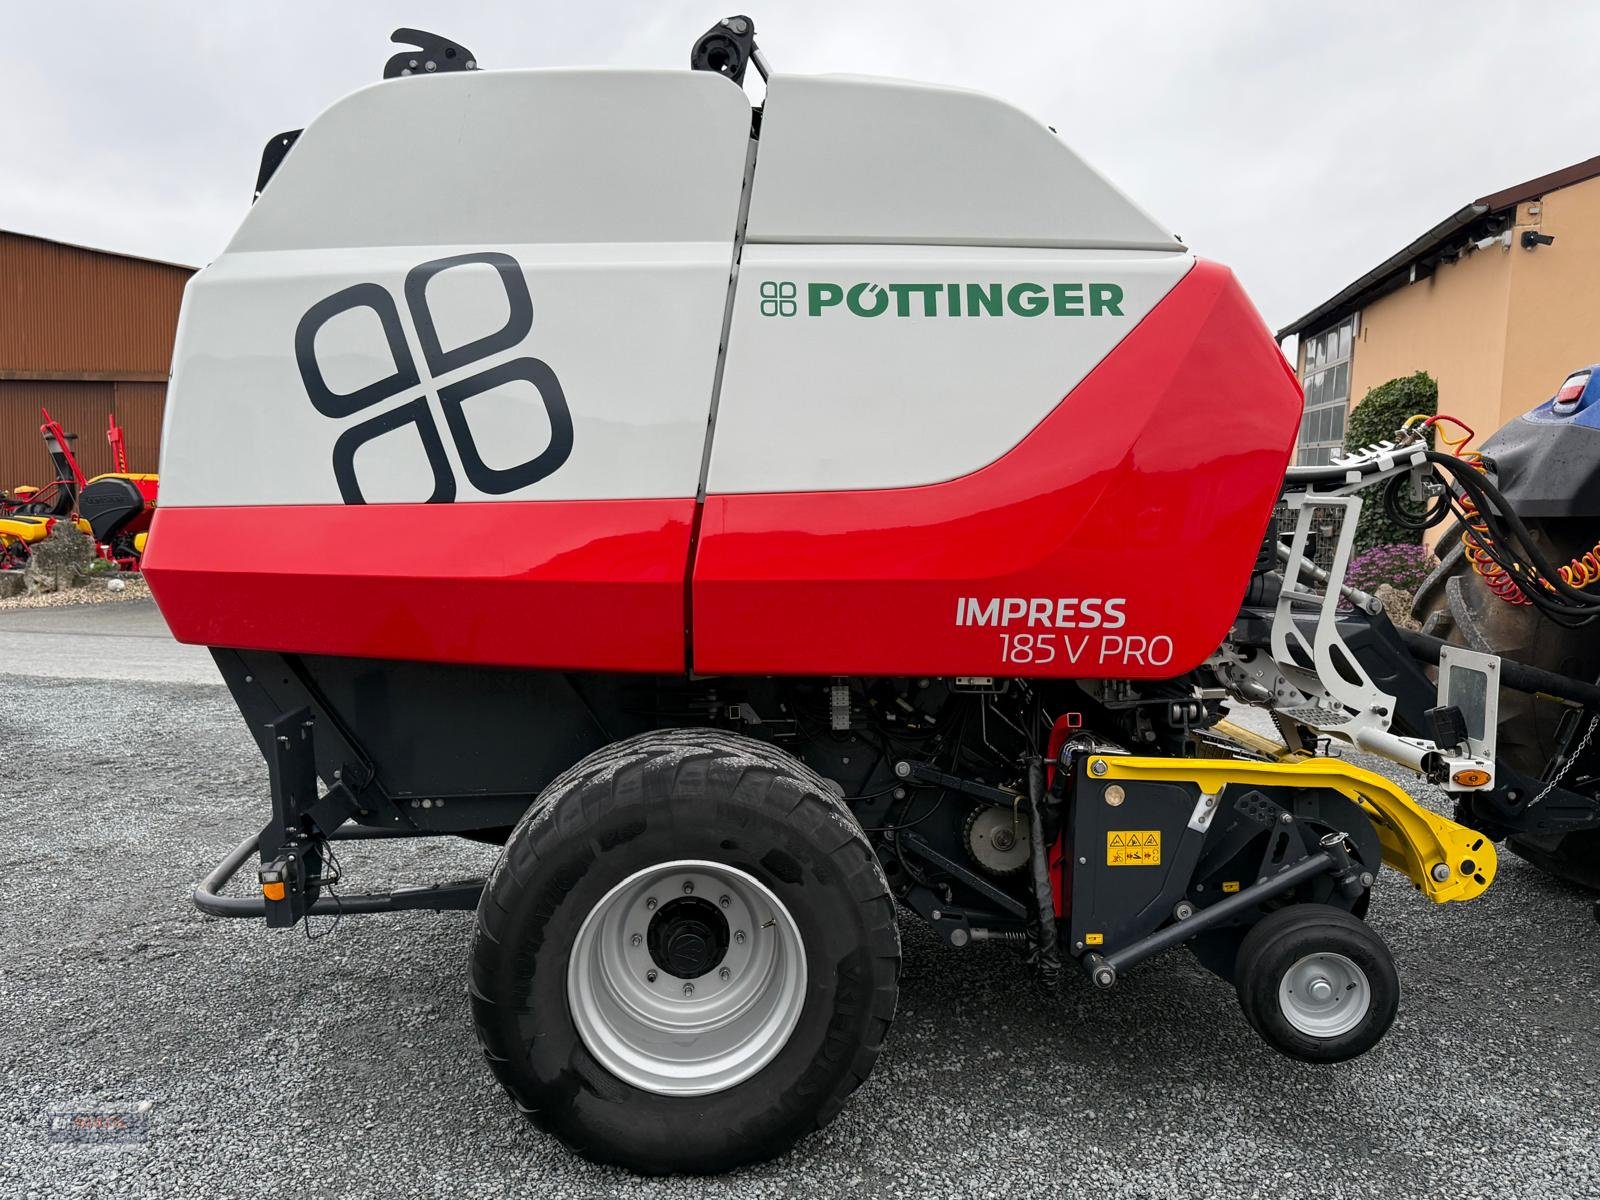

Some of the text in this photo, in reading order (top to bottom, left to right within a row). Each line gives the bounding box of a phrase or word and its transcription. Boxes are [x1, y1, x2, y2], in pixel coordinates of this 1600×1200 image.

[809, 284, 1123, 317] PÖTTINGER
[956, 598, 1125, 628] IMPRESS
[1000, 634, 1173, 665] 185 V PRO
